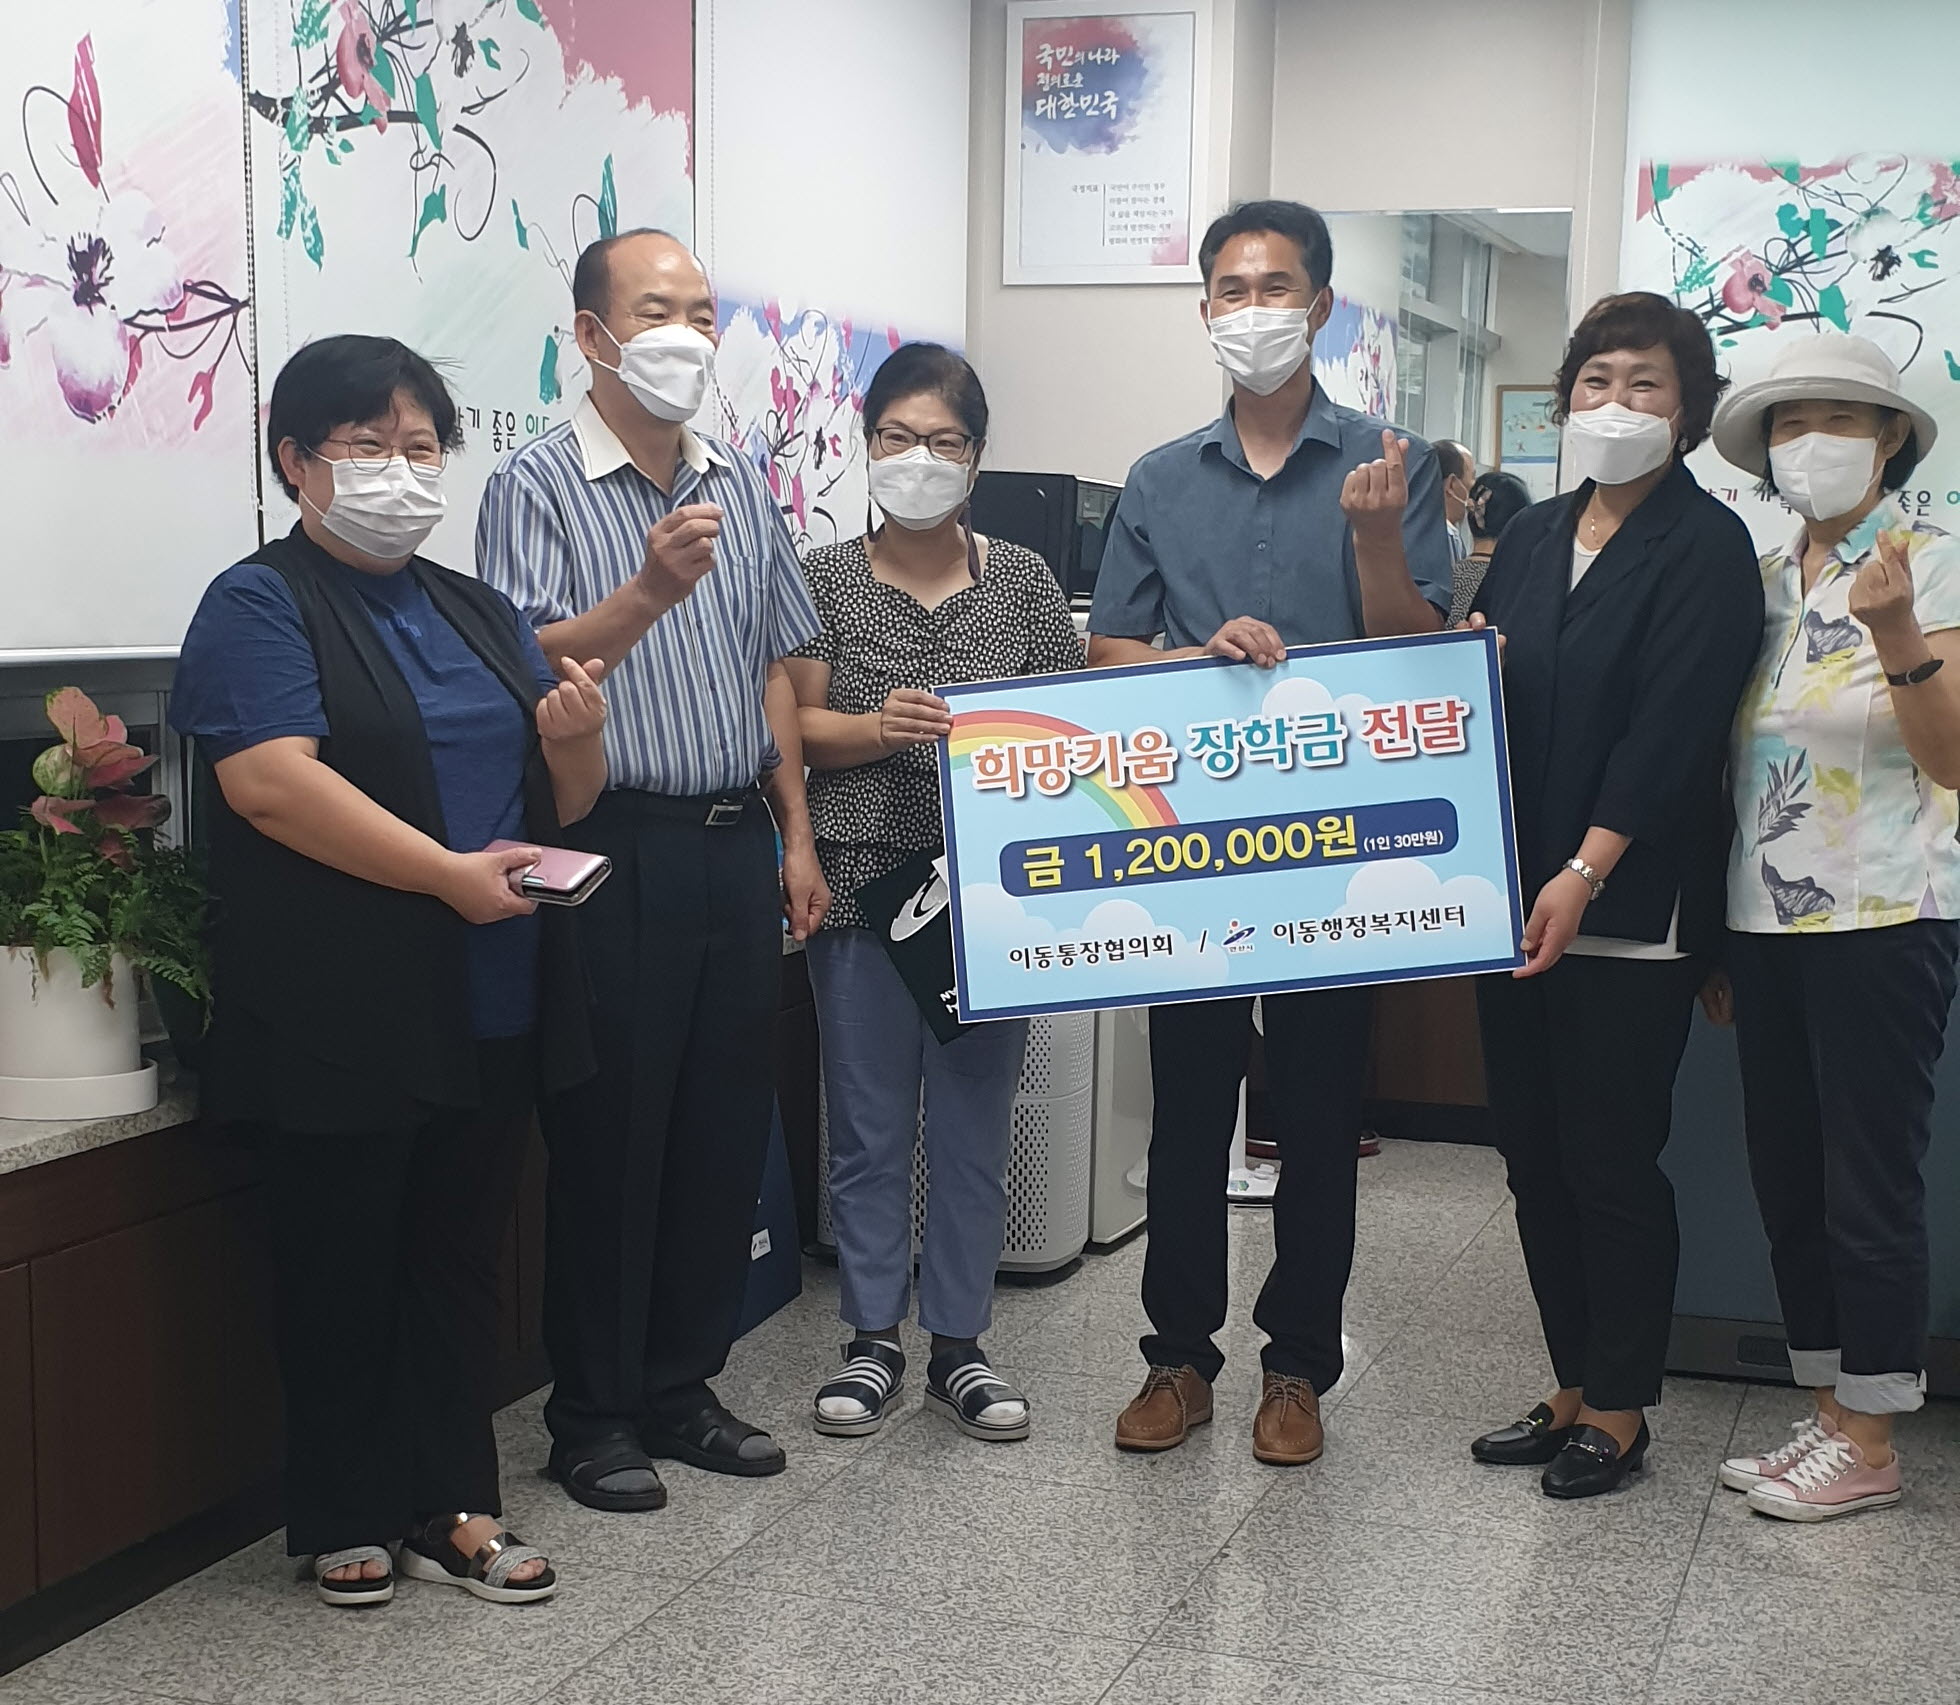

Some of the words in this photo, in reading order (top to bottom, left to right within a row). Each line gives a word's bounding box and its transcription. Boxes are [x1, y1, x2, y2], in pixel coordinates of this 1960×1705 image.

[1035, 43, 1085, 71] 국민의
[1088, 47, 1121, 65] 나라
[1036, 72, 1084, 92] 정의로운
[1035, 90, 1120, 120] 대한민국
[492, 409, 517, 453] 좋은
[974, 729, 1174, 794] 희망키움
[1189, 711, 1344, 774] 장학금
[1361, 699, 1466, 756] 전달
[1022, 845, 1066, 889] 금
[1084, 814, 1358, 883] 1,200,000원
[1363, 835, 1391, 853] (1인
[1393, 830, 1445, 849] 30만원)
[1008, 933, 1174, 971] 이동통장협의회
[1272, 905, 1466, 945] 이동행정복지센터
